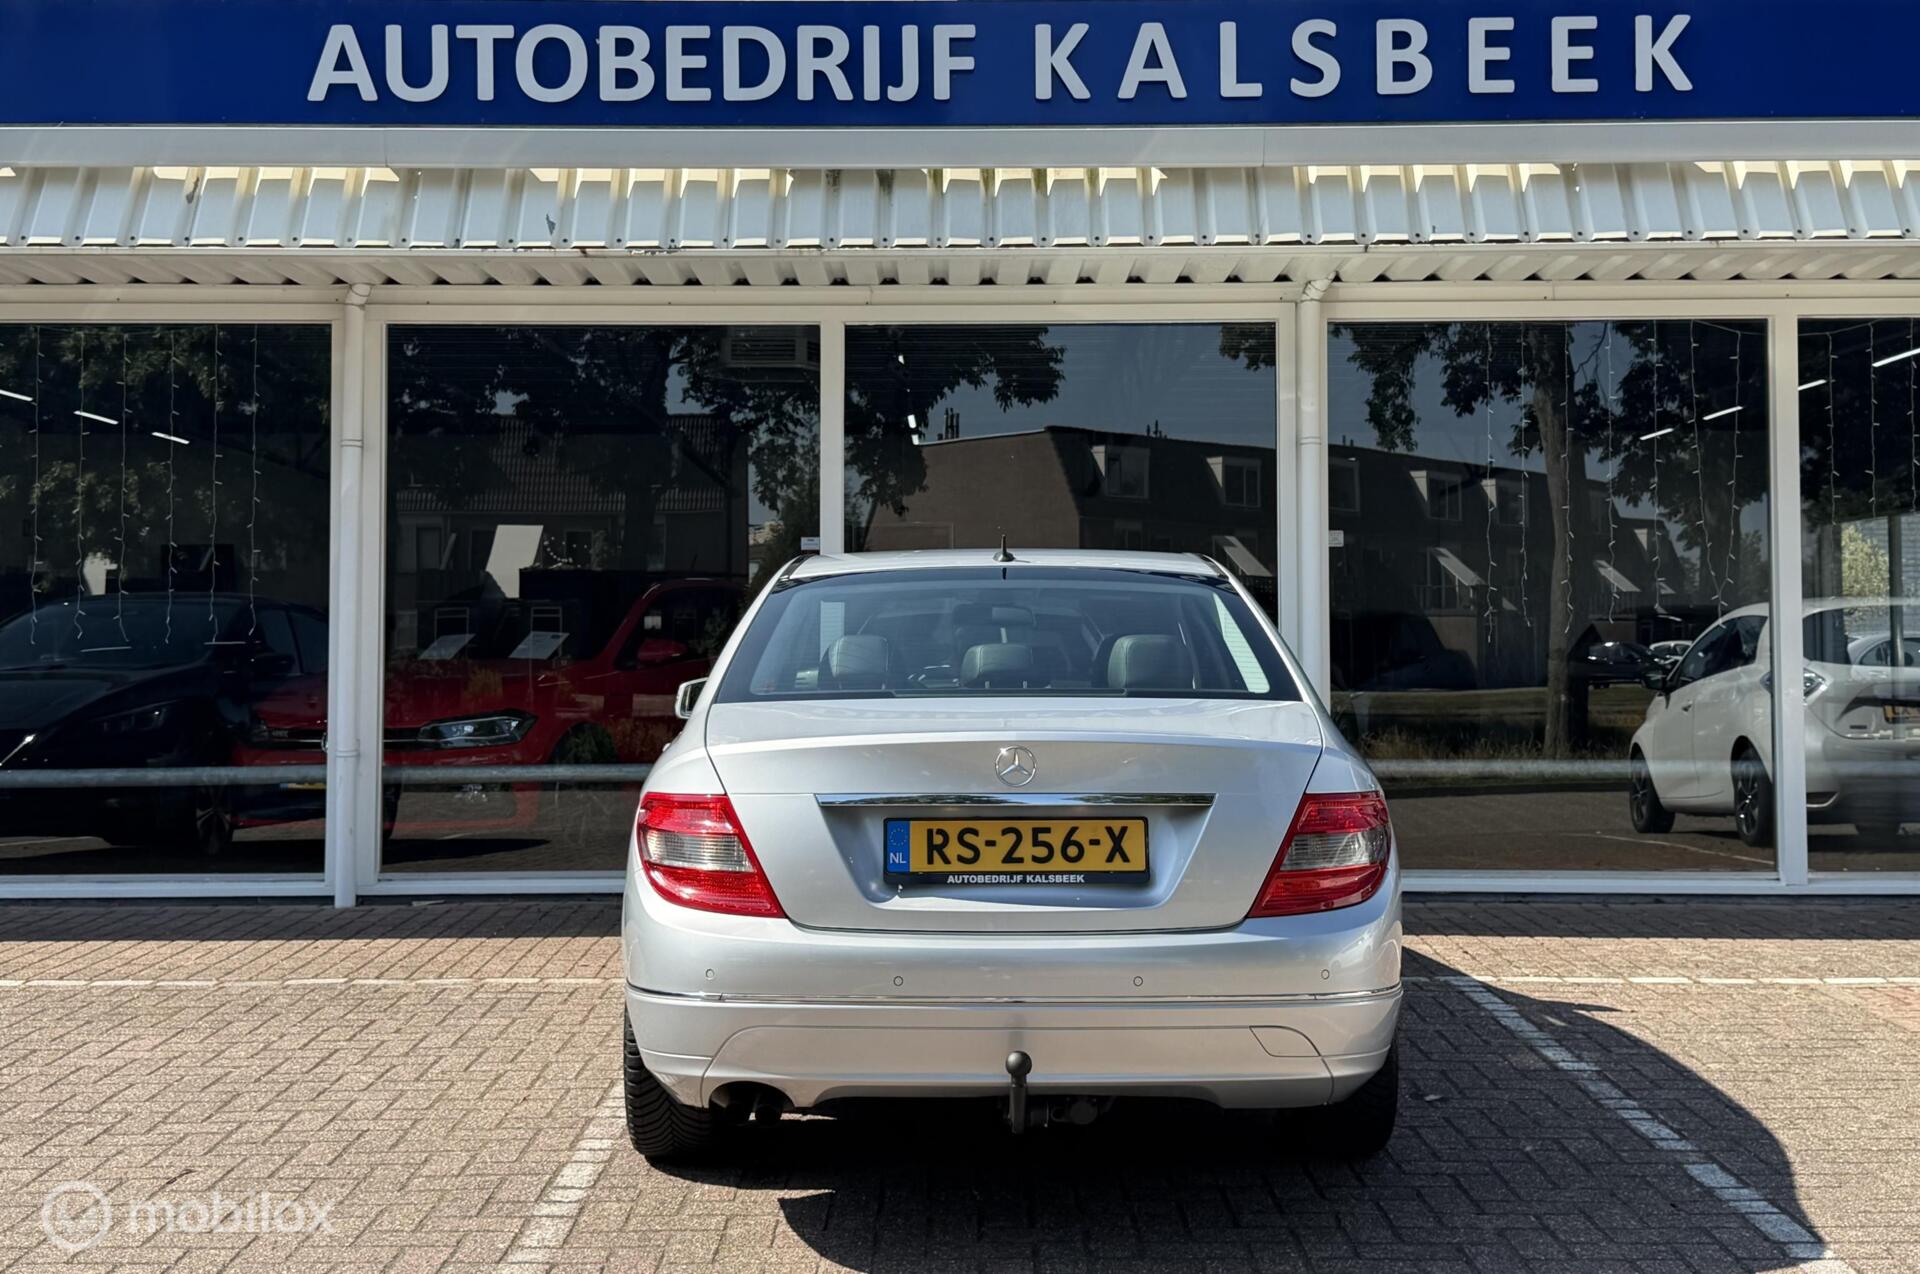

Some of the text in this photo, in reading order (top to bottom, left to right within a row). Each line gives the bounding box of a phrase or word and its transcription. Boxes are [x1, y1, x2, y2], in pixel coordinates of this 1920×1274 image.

[307, 14, 1694, 102] AUTOBEDRIJF KALSBEEK
[889, 852, 907, 865] NL
[926, 825, 1131, 866] RS-256-X
[946, 874, 1085, 885] AUTOBEDRIJF KALSBEEK
